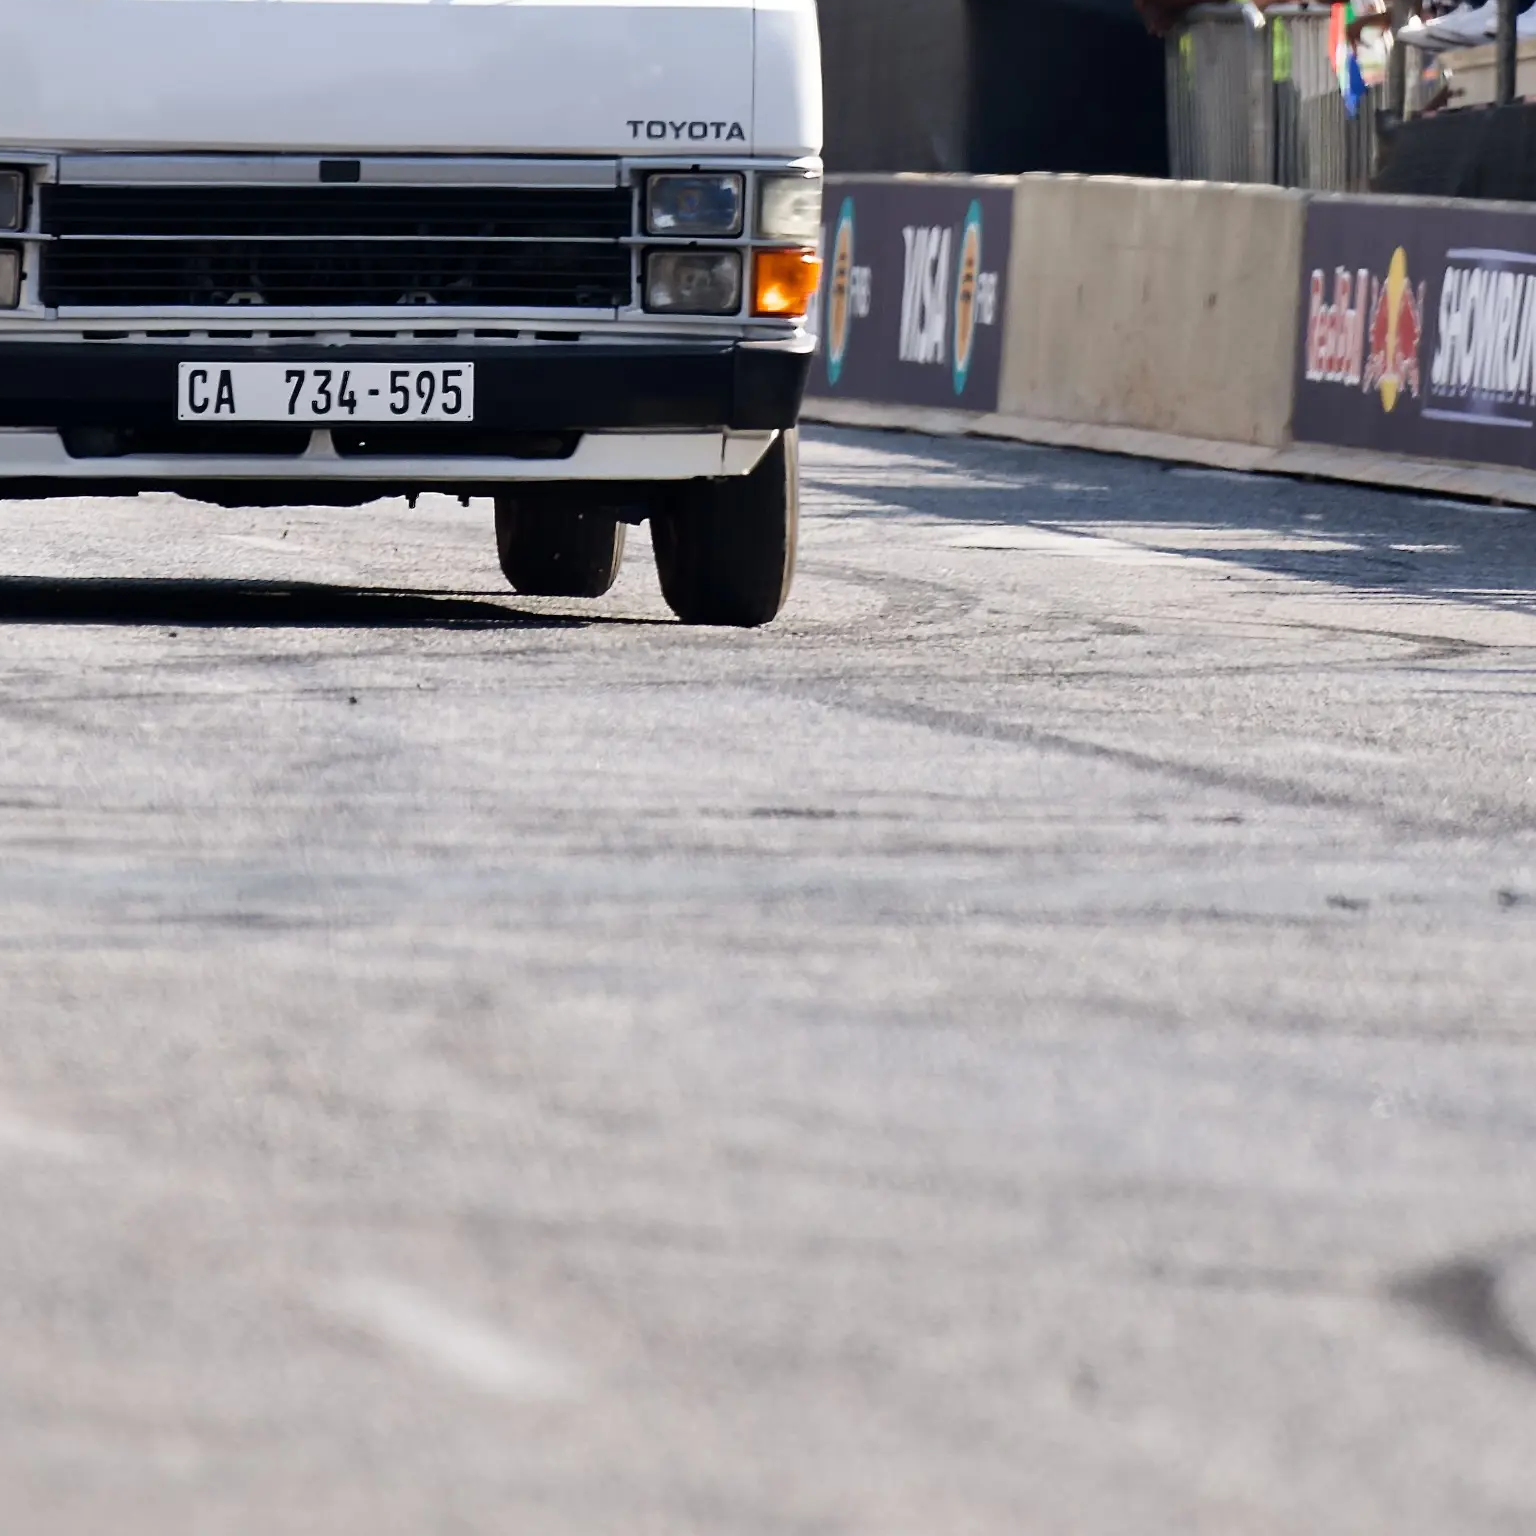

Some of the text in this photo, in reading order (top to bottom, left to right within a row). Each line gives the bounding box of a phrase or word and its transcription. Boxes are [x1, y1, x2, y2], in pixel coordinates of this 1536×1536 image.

[626, 120, 745, 141] TOYOTA
[898, 225, 951, 364] VISA
[188, 369, 464, 415] CA 734-595
